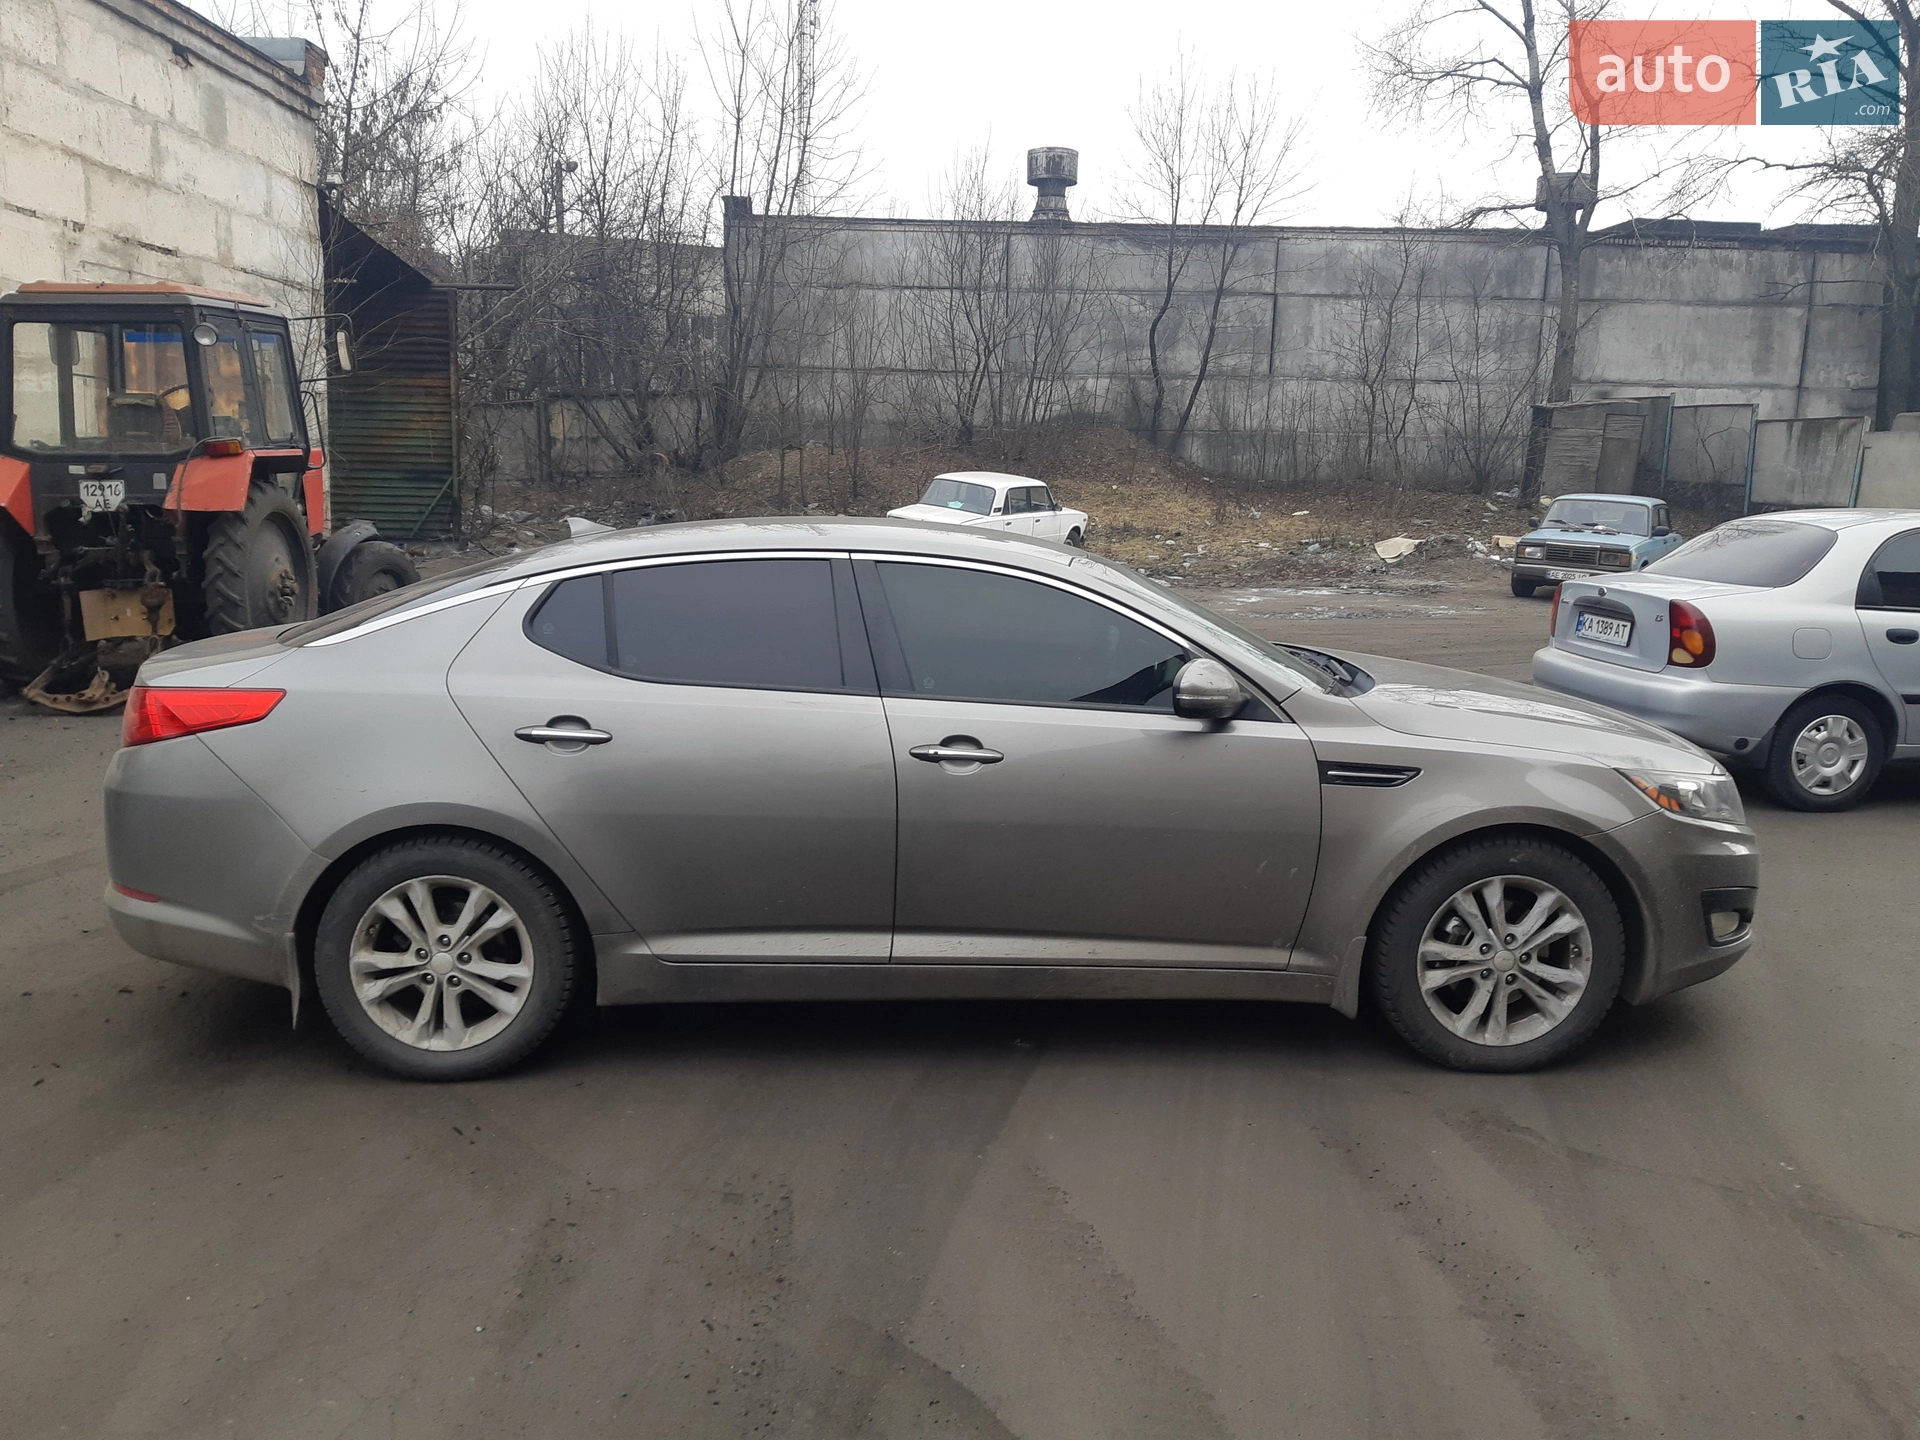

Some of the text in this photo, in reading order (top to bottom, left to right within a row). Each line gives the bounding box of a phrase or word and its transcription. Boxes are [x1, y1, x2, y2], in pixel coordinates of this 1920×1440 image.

[94, 499, 112, 510] AE
[1583, 616, 1593, 632] KA
[1596, 619, 1614, 636] 1389
[1613, 623, 1628, 639] AT
